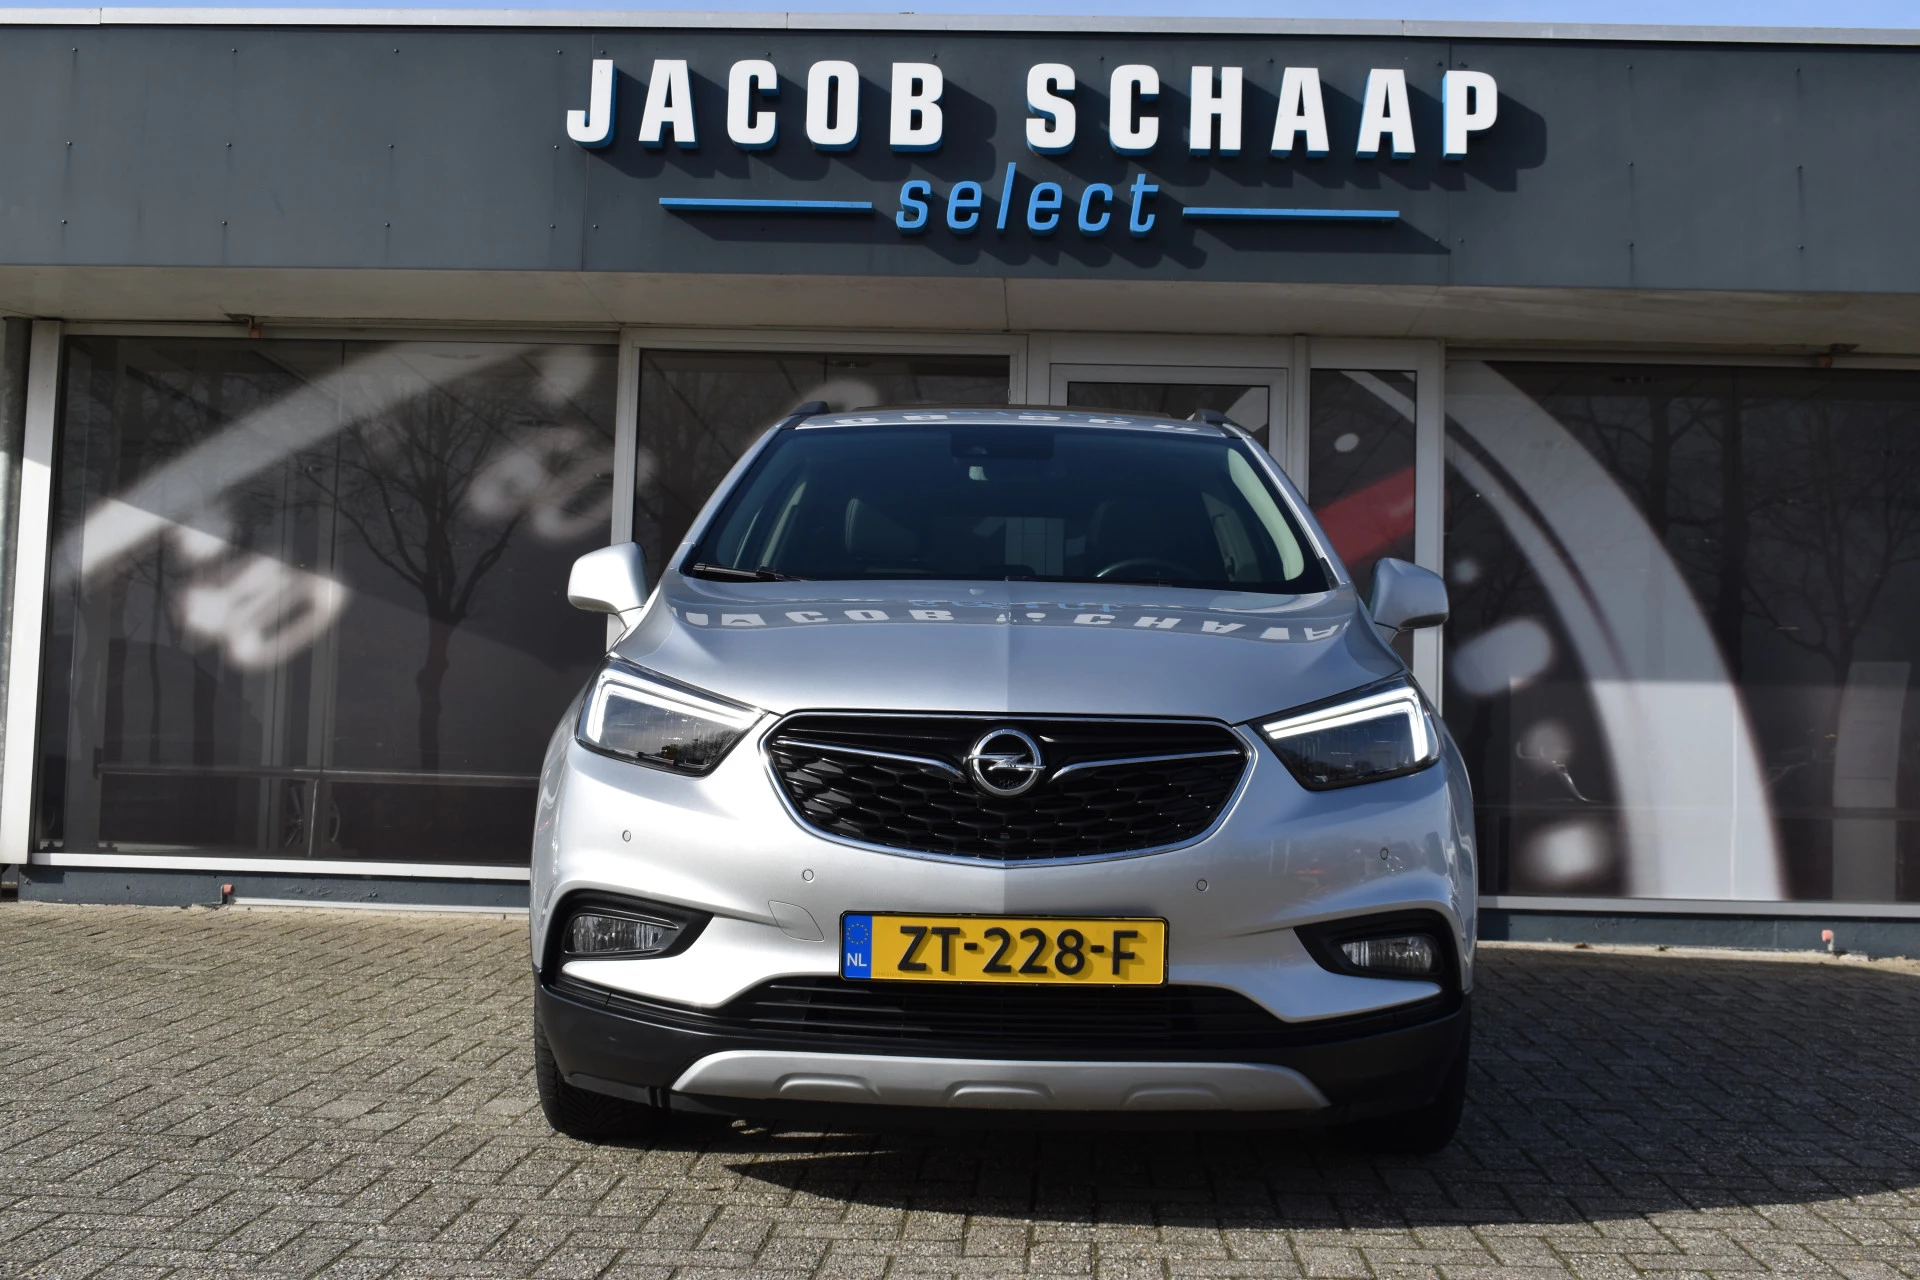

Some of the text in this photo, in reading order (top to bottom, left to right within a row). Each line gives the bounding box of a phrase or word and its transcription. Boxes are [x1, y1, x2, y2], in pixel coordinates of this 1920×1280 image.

[566, 58, 1499, 160] JACOB SCHAAP
[895, 161, 1160, 237] select
[845, 952, 868, 968] NL
[897, 925, 1139, 976] ZT-228-F
